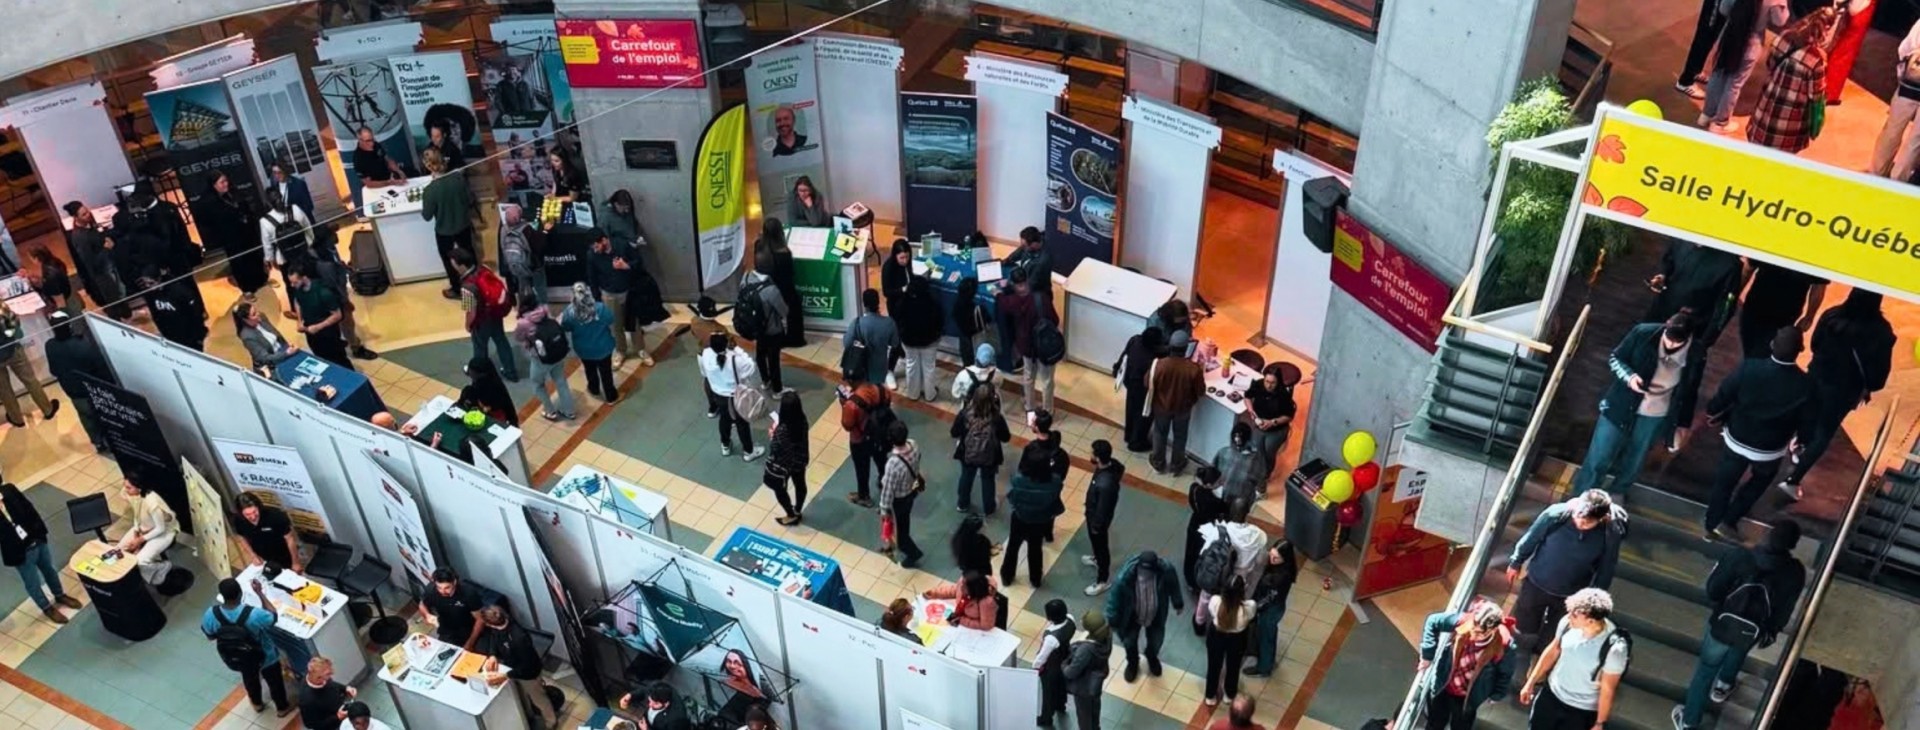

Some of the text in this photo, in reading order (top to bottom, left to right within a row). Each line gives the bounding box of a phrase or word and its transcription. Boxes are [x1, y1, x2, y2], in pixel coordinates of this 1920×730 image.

[611, 39, 676, 51] Carrefour
[395, 62, 413, 72] TCI
[612, 53, 680, 66] de l'emploi
[231, 69, 277, 90] GEYSER
[399, 74, 441, 84] Donnez de
[401, 81, 444, 92] l'impulsion
[763, 73, 798, 90] CNESST
[409, 90, 430, 98] votre
[180, 153, 242, 176] GEYSER
[709, 150, 727, 209] CNESST
[1640, 165, 1713, 201] Salle
[1374, 260, 1430, 305] Carrefour
[1370, 275, 1383, 288] de
[1384, 281, 1428, 320] l'emploi
[249, 474, 303, 489] RAISONS
